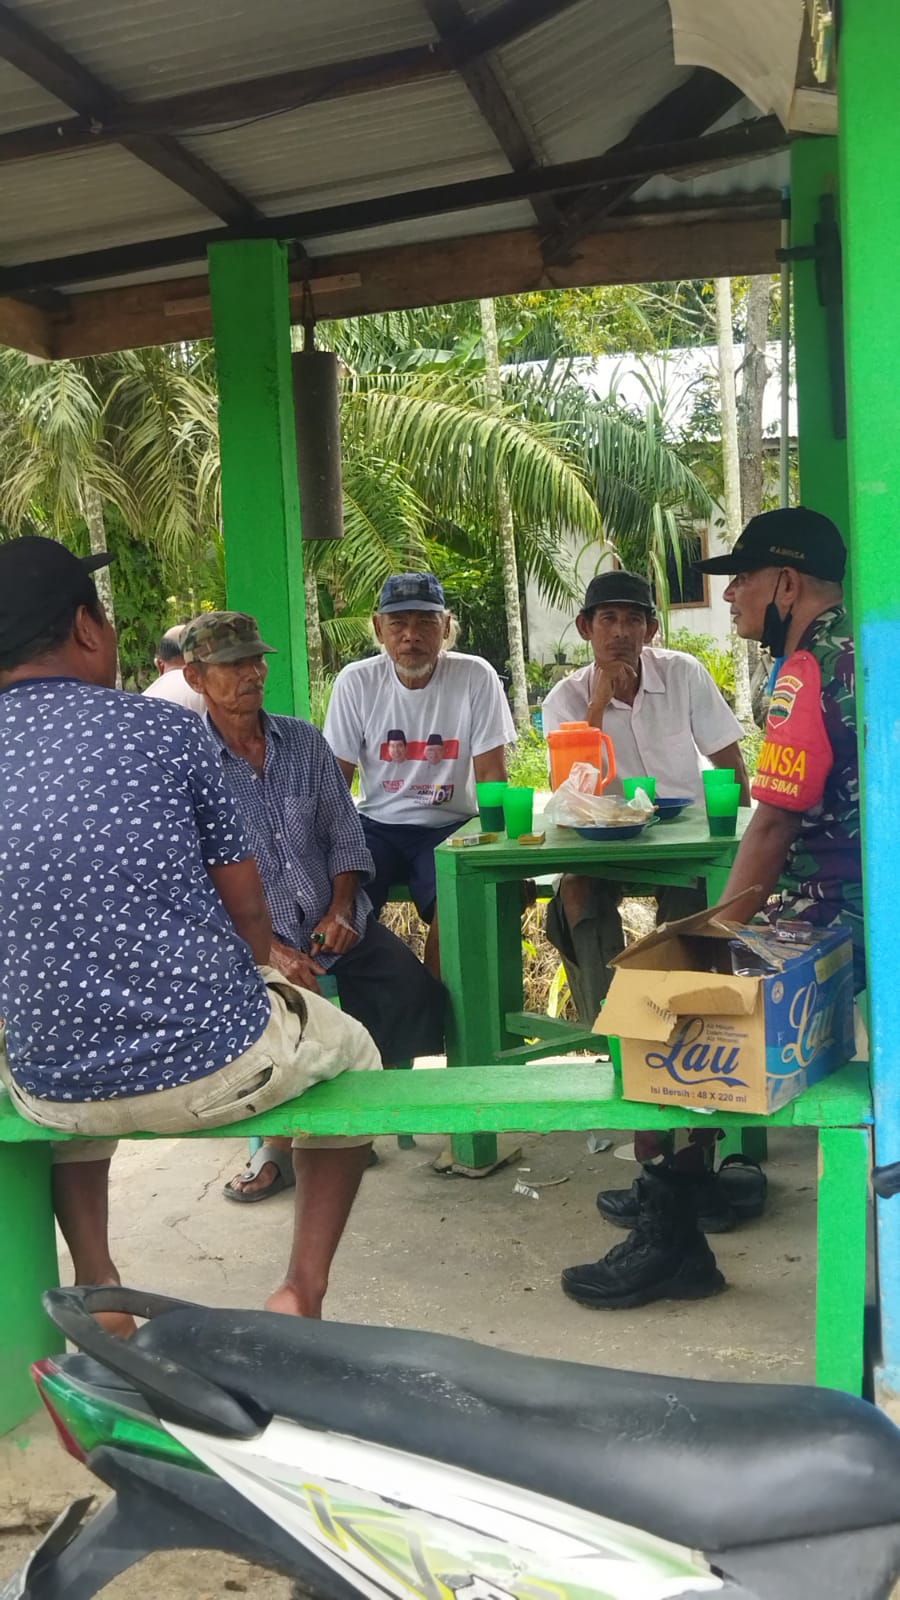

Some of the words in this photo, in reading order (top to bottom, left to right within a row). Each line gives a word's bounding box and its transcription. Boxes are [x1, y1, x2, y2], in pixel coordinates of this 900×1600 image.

[650, 1086, 661, 1095] Isi
[662, 1087, 690, 1098] Bersih
[697, 1090, 707, 1099] 48
[718, 1093, 734, 1102] 220
